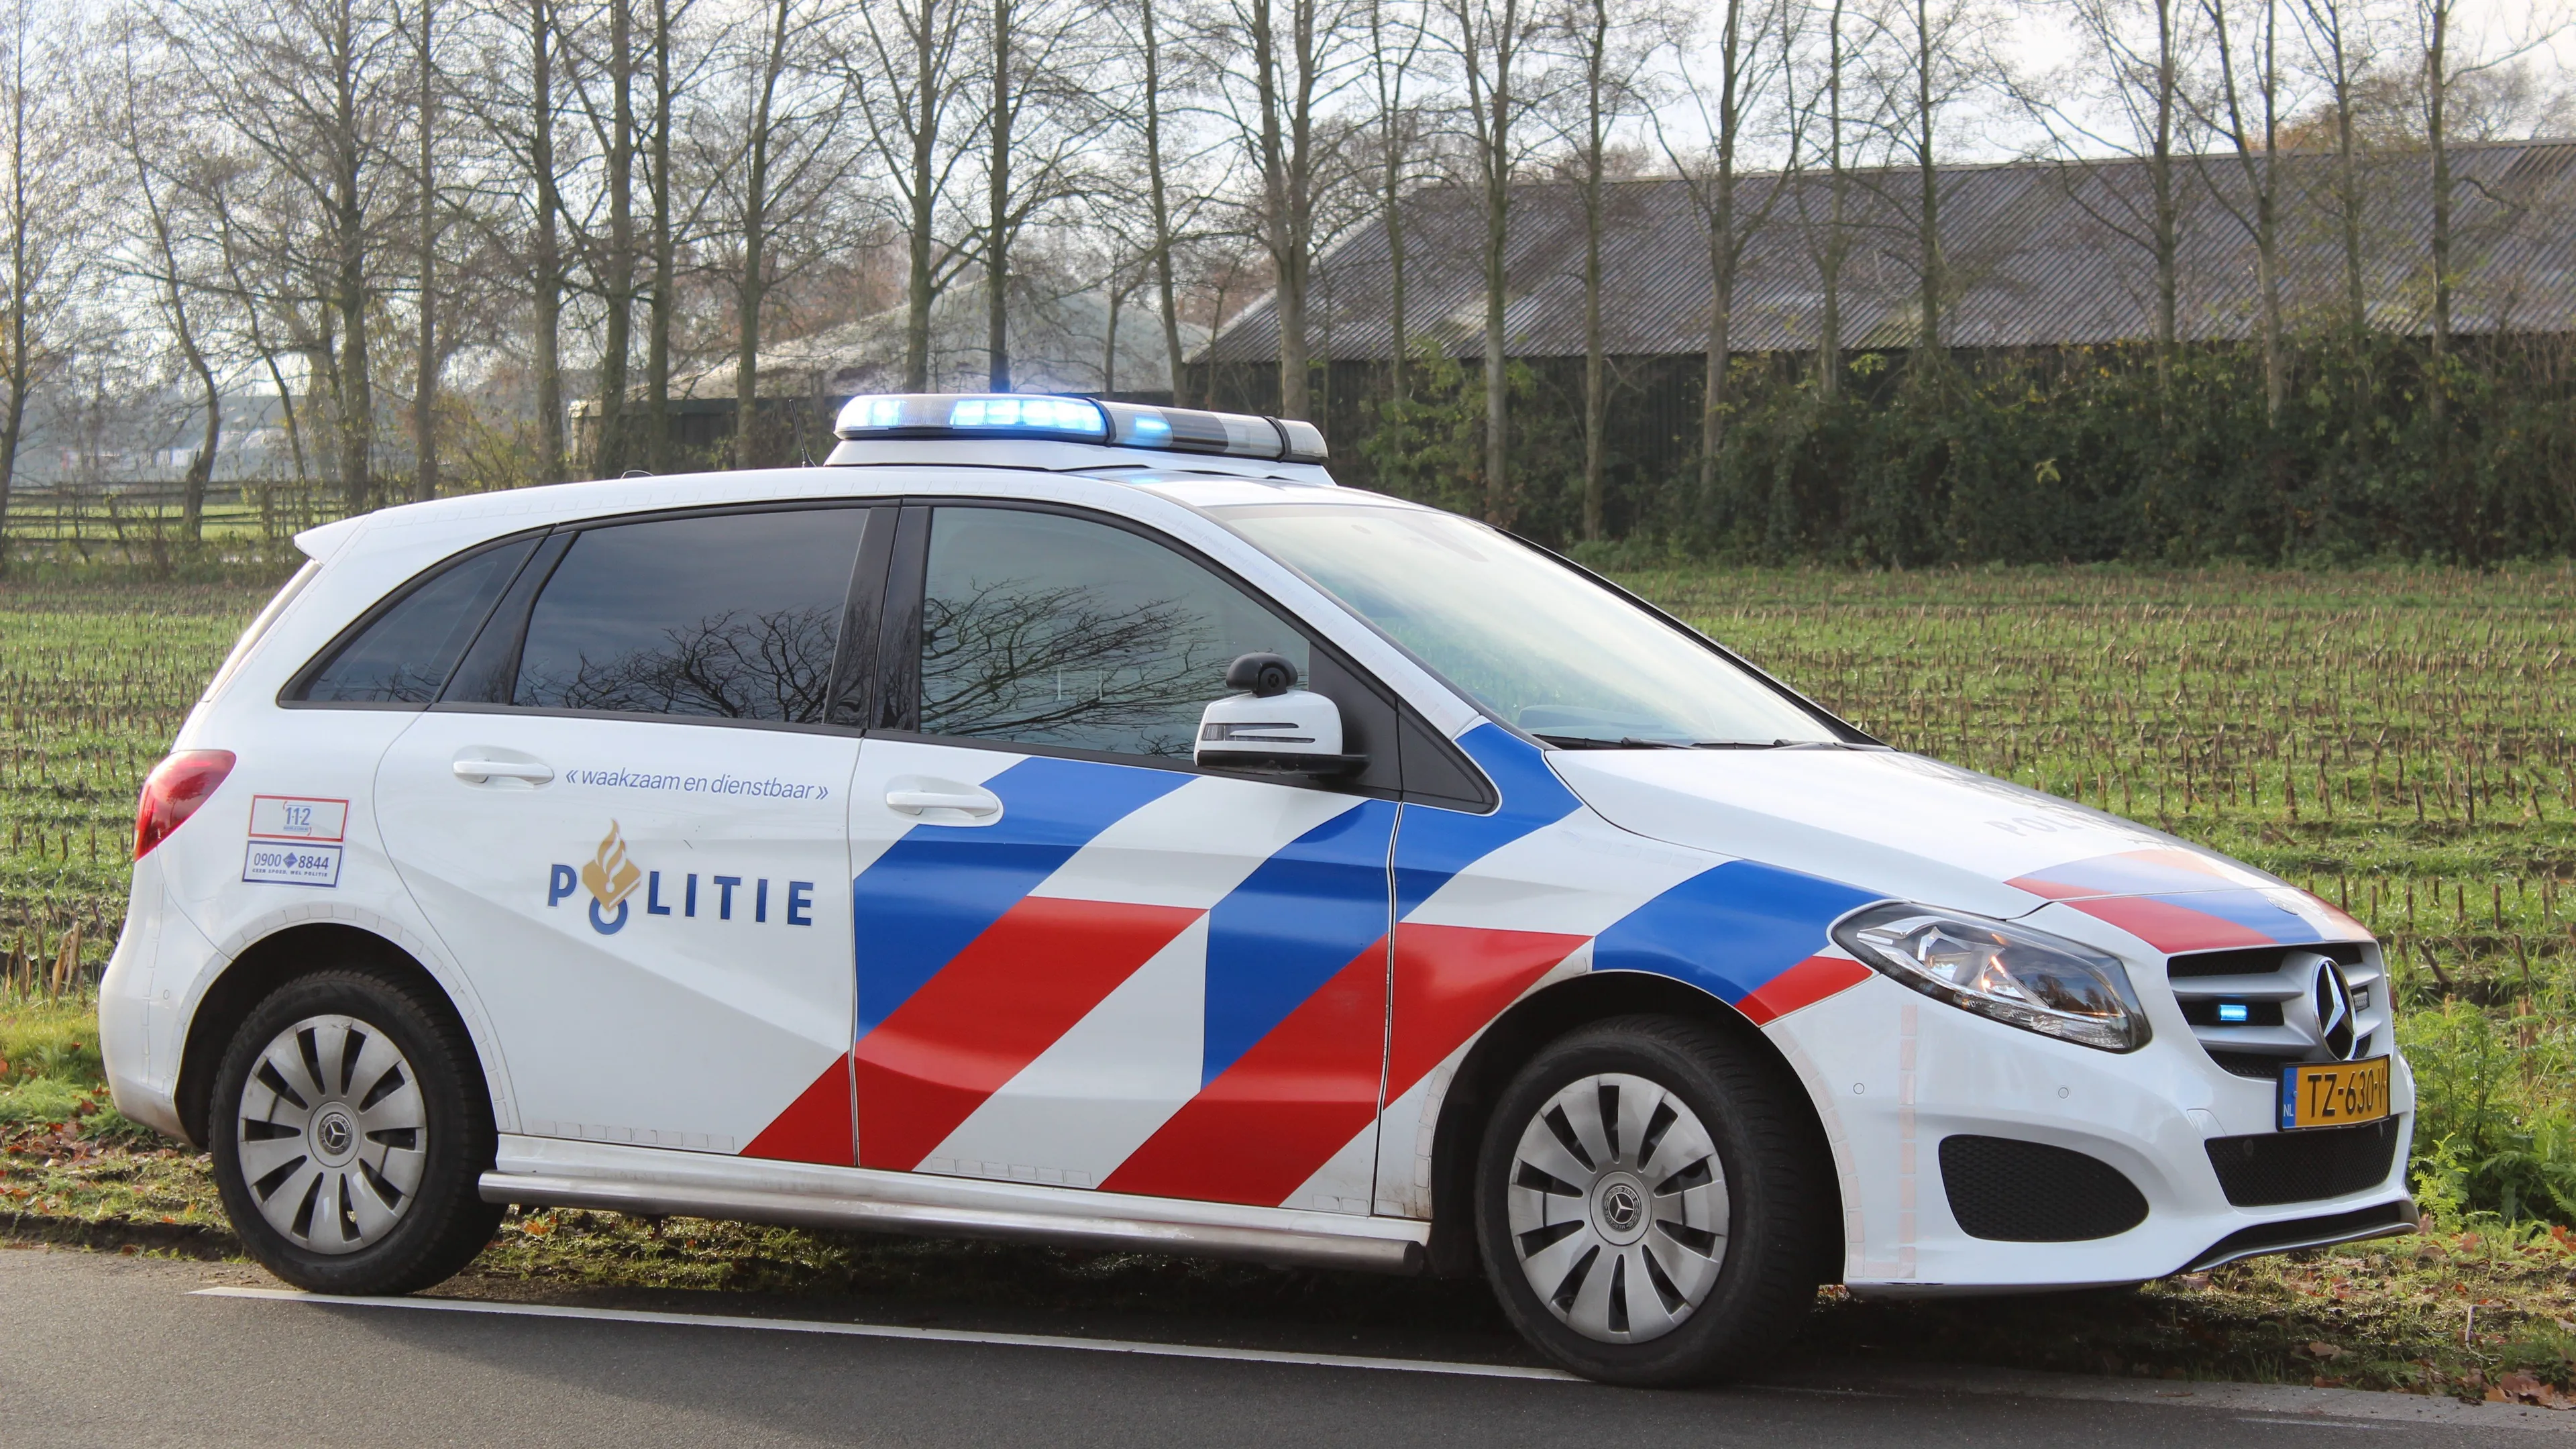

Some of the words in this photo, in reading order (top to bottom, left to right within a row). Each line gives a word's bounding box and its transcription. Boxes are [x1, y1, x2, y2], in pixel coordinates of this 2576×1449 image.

[582, 767, 680, 790] waakzaam
[684, 777, 707, 793] en
[711, 773, 814, 799] dienstbaar
[254, 853, 282, 867] 0900
[298, 855, 329, 869] 8844
[547, 863, 814, 935] POLITIE
[2284, 1104, 2294, 1117] NL
